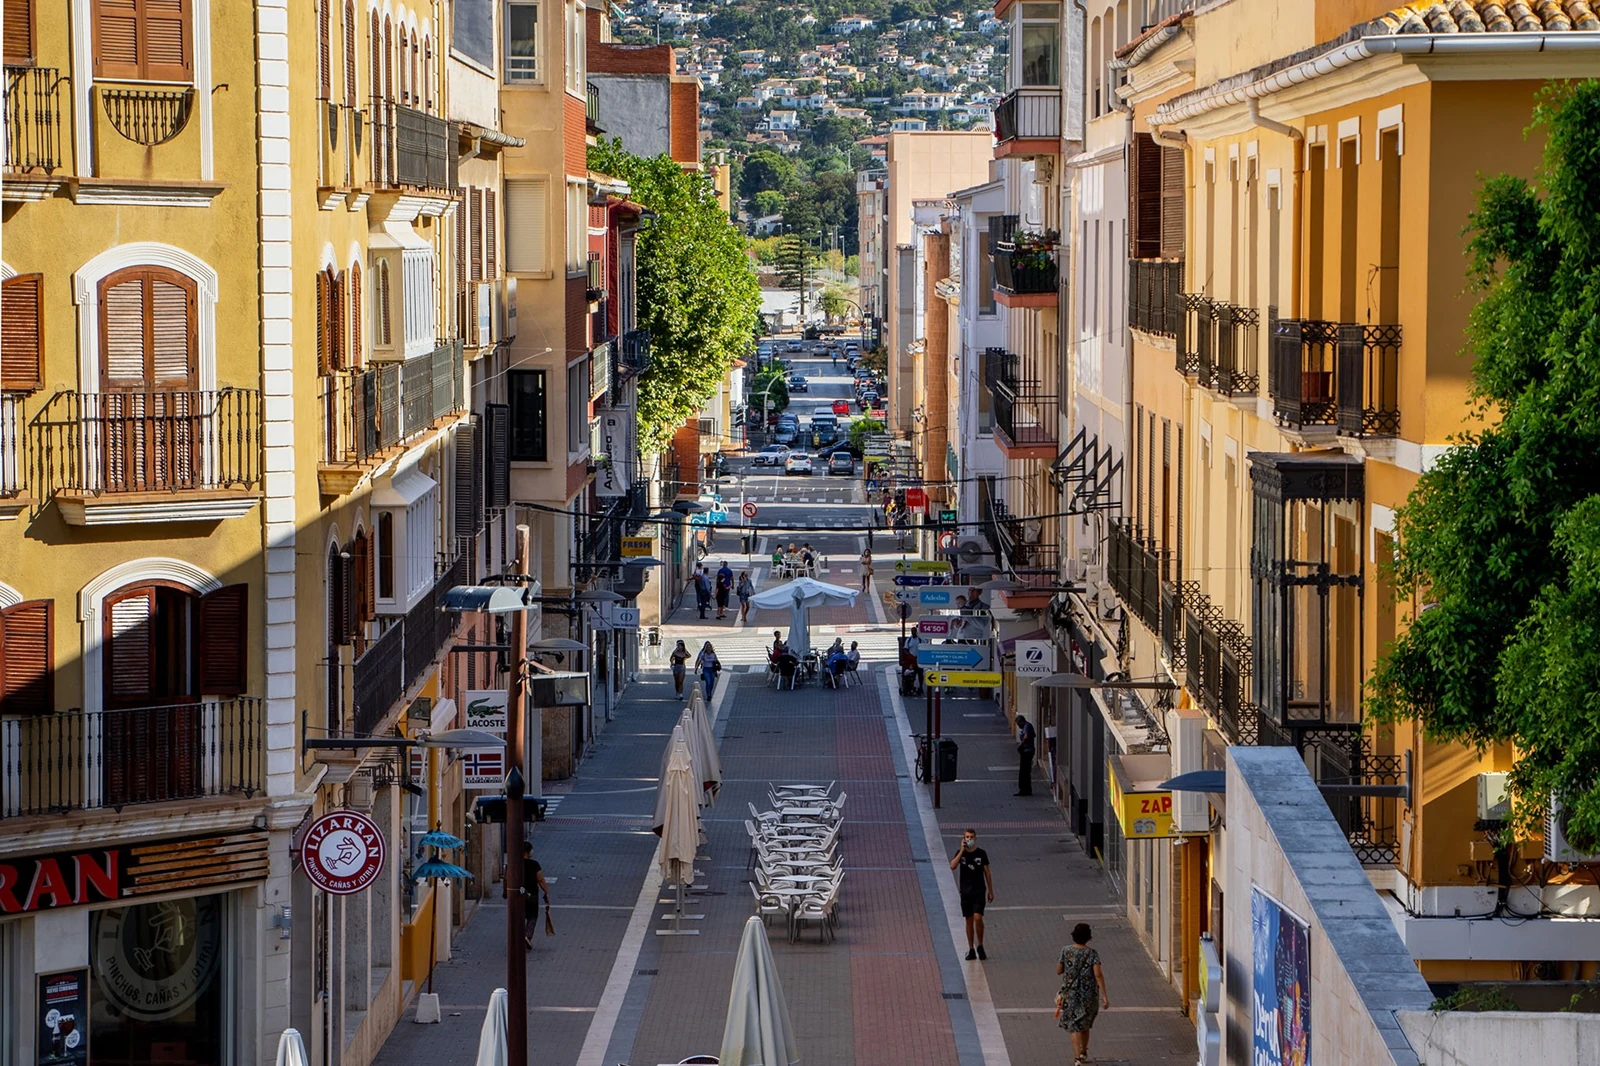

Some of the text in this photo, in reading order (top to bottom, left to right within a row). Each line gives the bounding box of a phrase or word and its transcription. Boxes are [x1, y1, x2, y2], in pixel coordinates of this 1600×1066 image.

[467, 719, 505, 727] LACOSTE
[1141, 796, 1172, 814] ZAP
[307, 817, 379, 858] LIZARRAN
[329, 881, 351, 889] CAÑAS
[145, 986, 180, 1005] CAÑAS
[180, 979, 188, 991] Y
